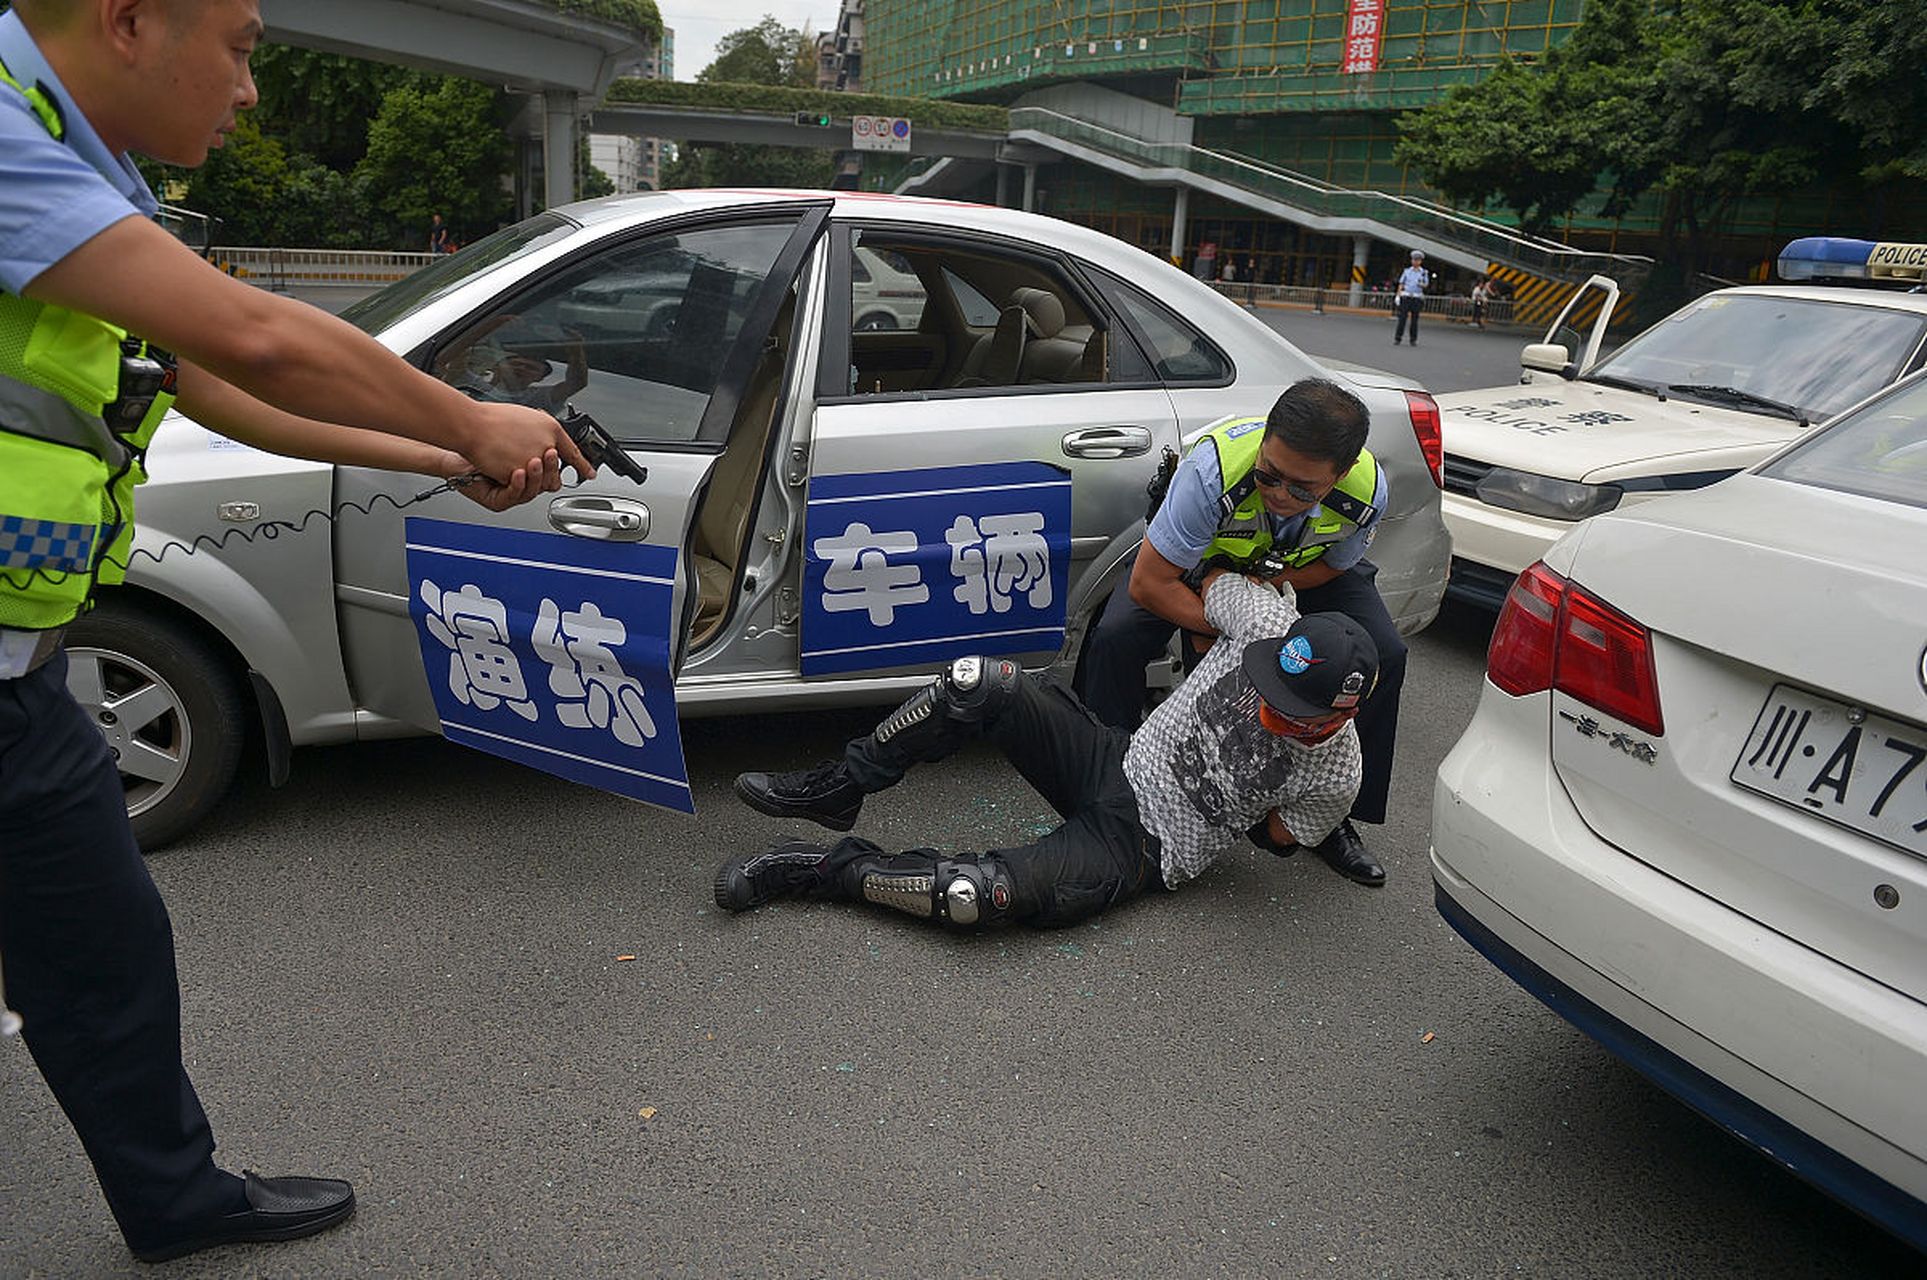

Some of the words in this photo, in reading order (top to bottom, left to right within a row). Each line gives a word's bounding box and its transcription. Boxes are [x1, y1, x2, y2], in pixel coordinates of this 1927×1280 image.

[1874, 246, 1927, 266] POLICE
[1445, 405, 1568, 436] POLICE
[812, 511, 1053, 627] 车辆
[420, 579, 658, 748] 演练
[1748, 704, 1927, 834] 川·A7
